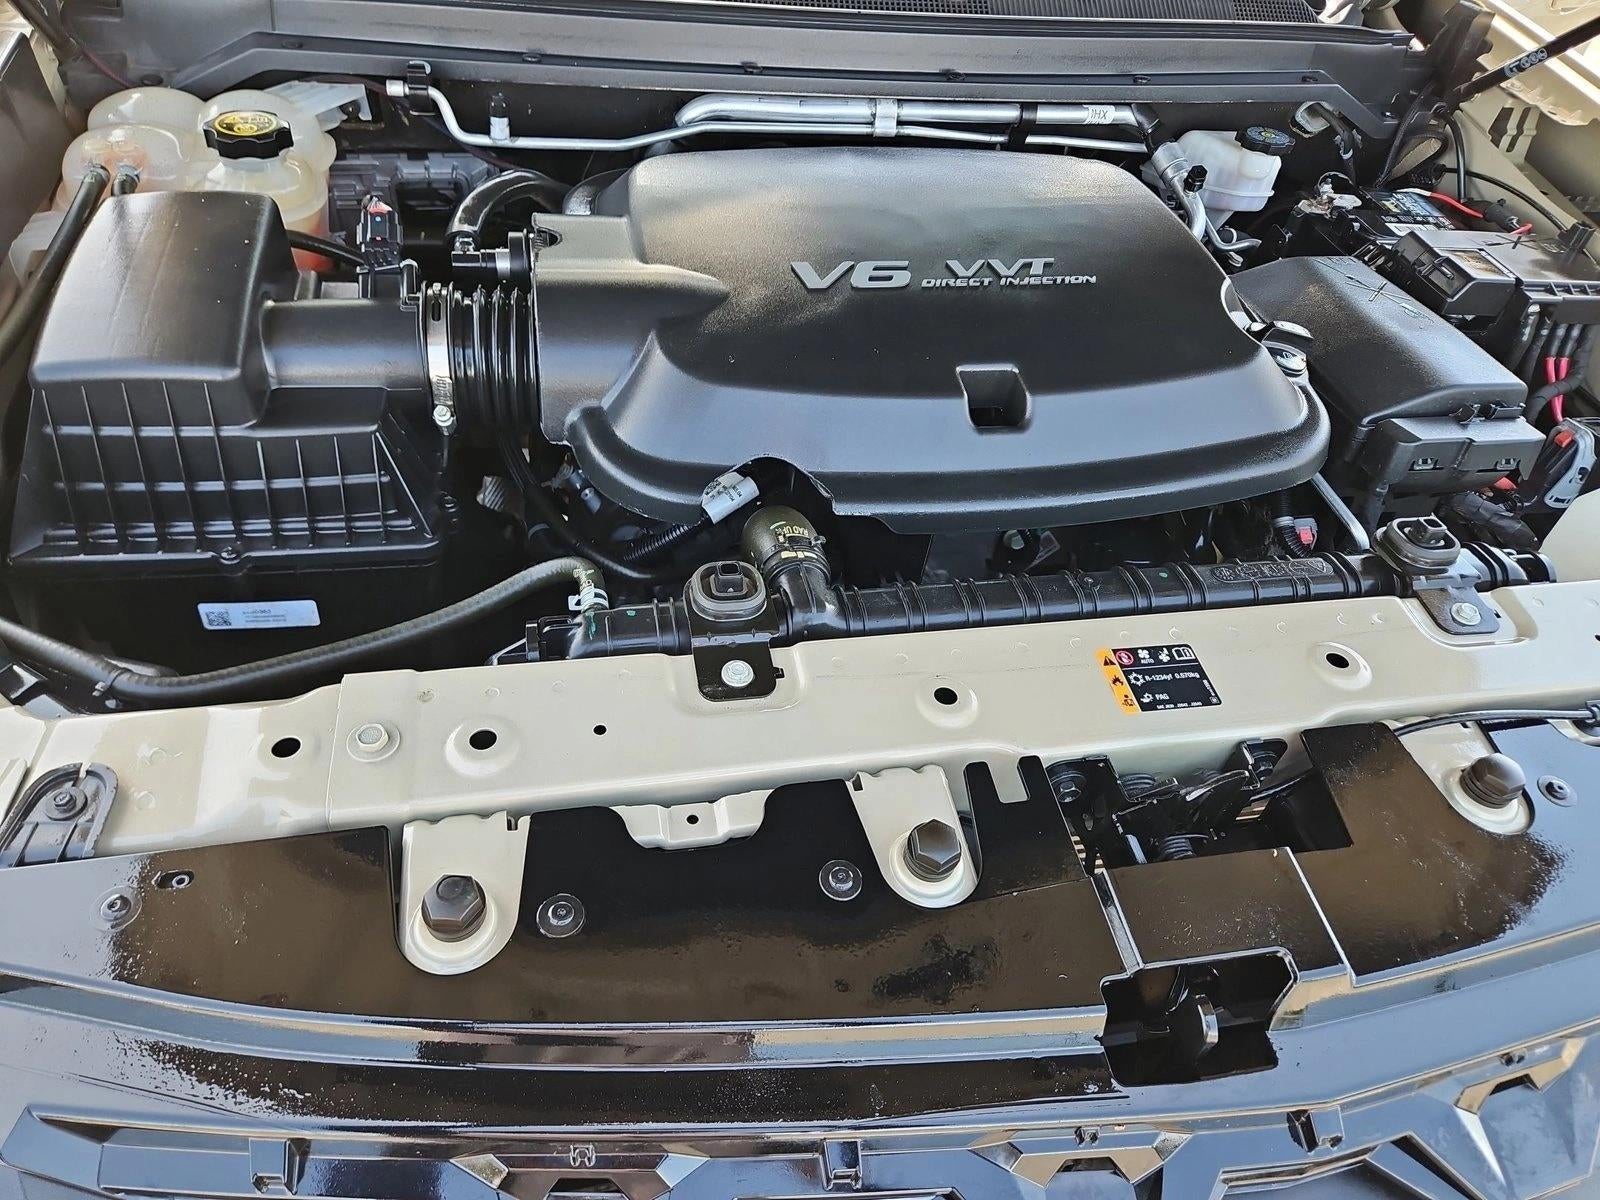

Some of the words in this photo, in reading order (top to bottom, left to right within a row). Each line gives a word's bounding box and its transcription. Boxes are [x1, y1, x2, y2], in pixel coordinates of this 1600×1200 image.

[791, 260, 912, 290] V6
[945, 257, 1055, 278] VVT
[921, 276, 993, 288] DIRECT
[1000, 275, 1097, 286] INJECTION
